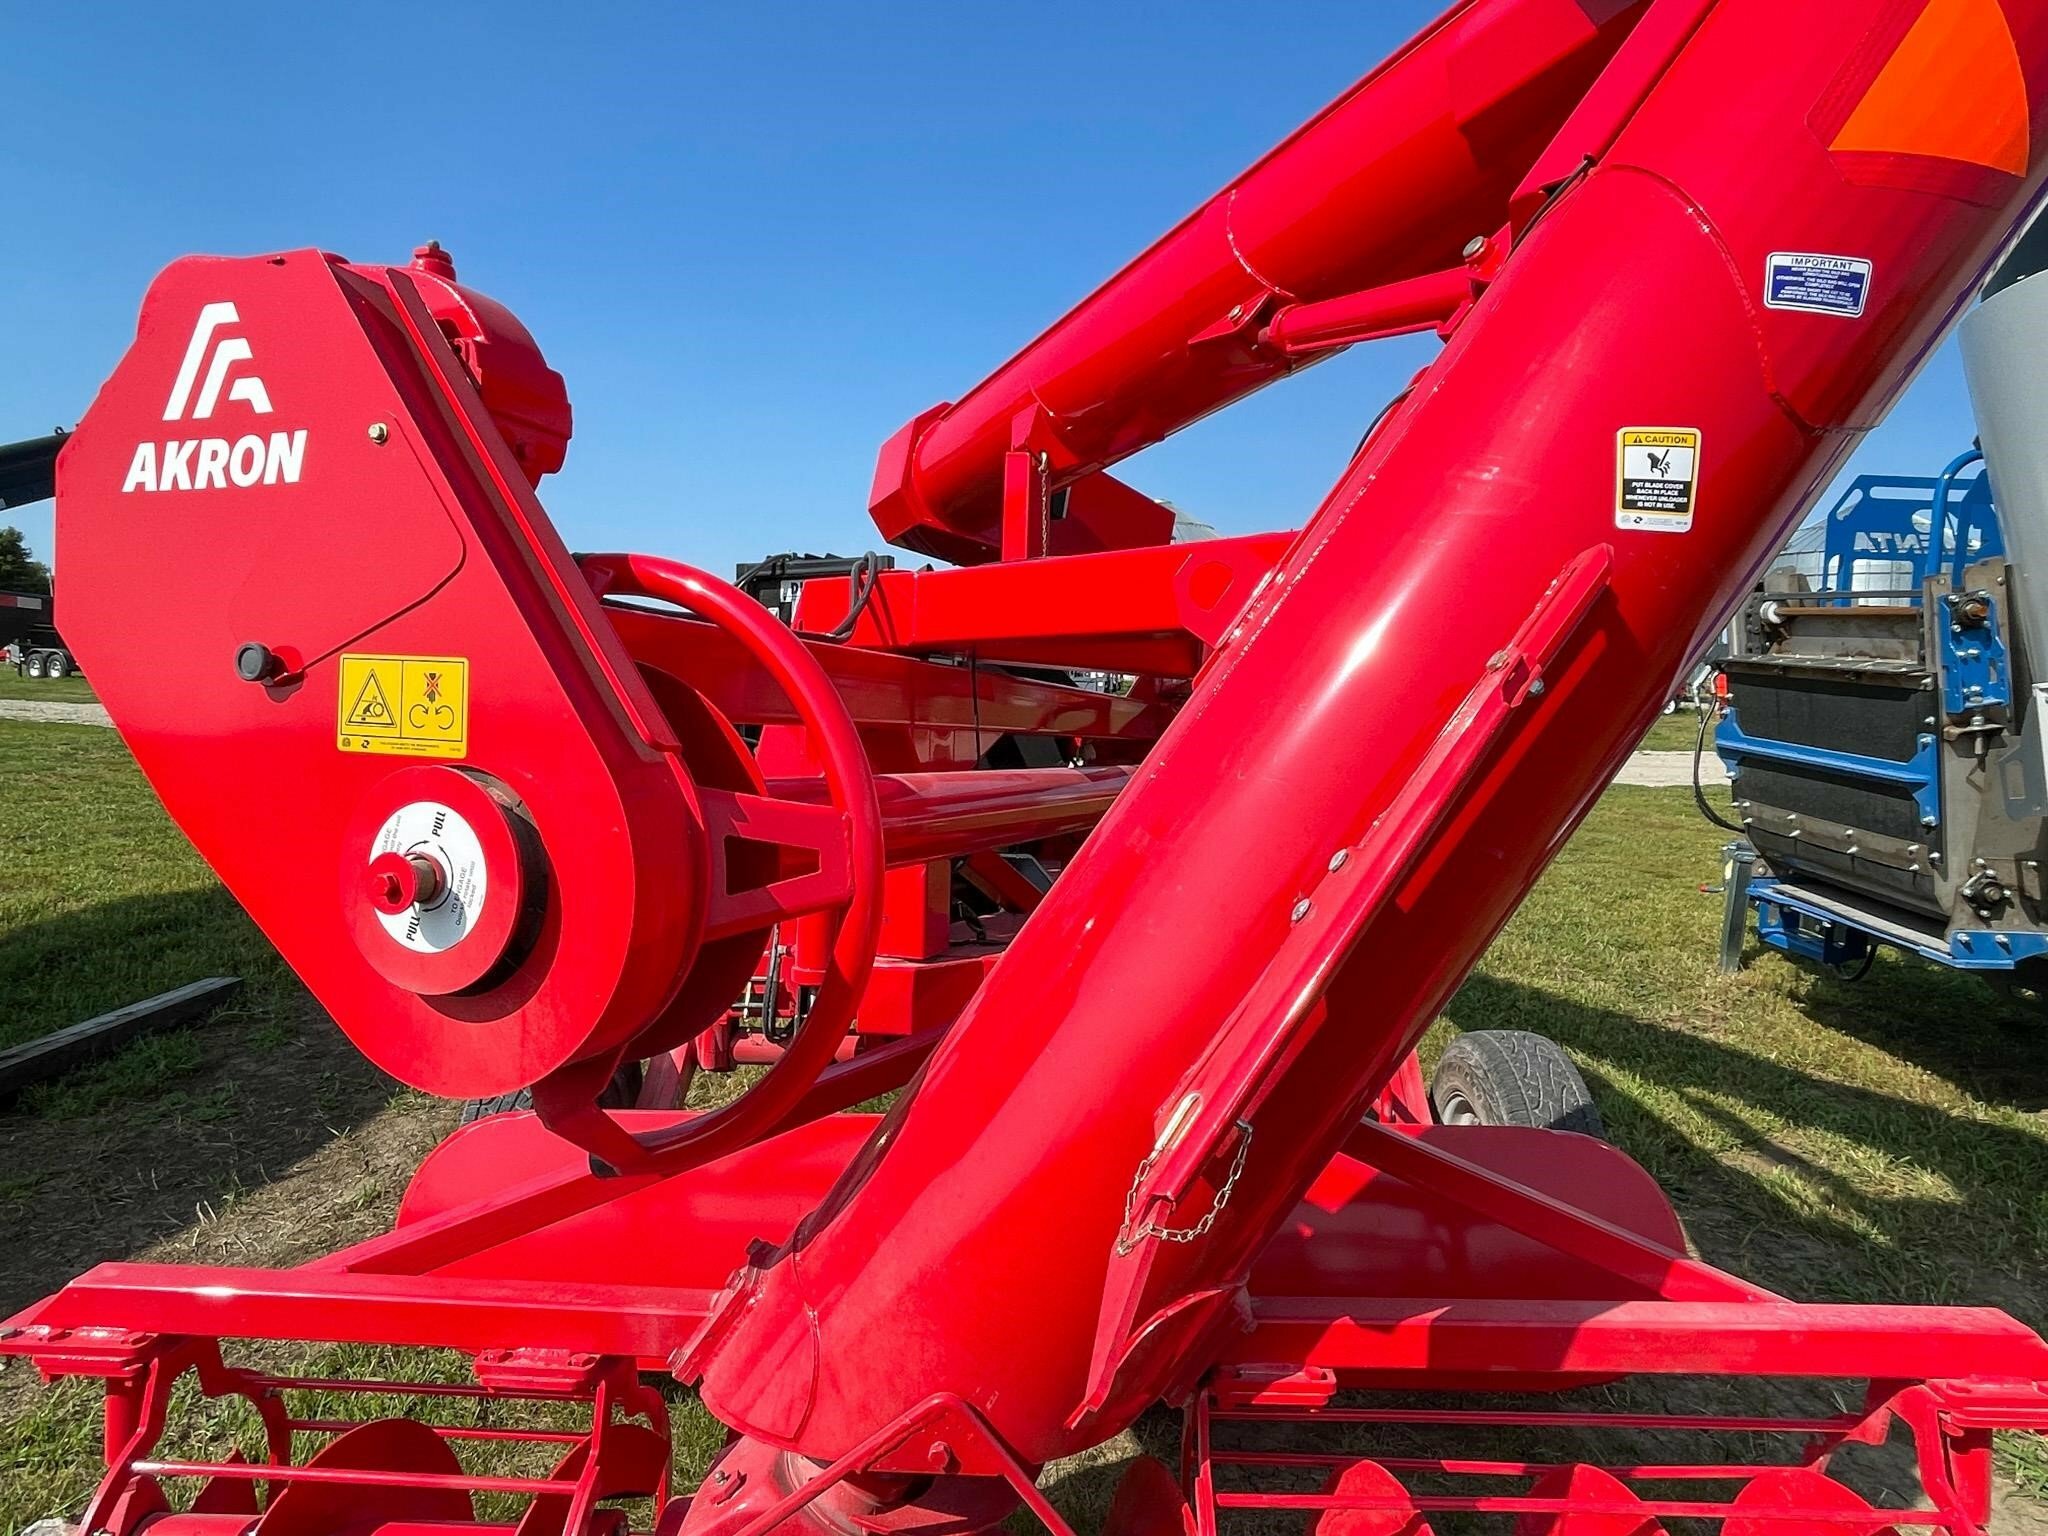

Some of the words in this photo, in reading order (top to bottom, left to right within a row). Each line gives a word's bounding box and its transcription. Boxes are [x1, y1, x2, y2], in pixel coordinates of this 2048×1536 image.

[1791, 258, 1853, 270] IMPORTANT
[1644, 436, 1688, 444] CAUTION
[121, 429, 308, 493] AKRON
[432, 811, 447, 837] PULL
[382, 827, 392, 851] GAGE
[454, 867, 467, 901] ENGAGE
[463, 878, 471, 899] rotate
[451, 903, 458, 913] TO
[406, 915, 421, 942] PULL
